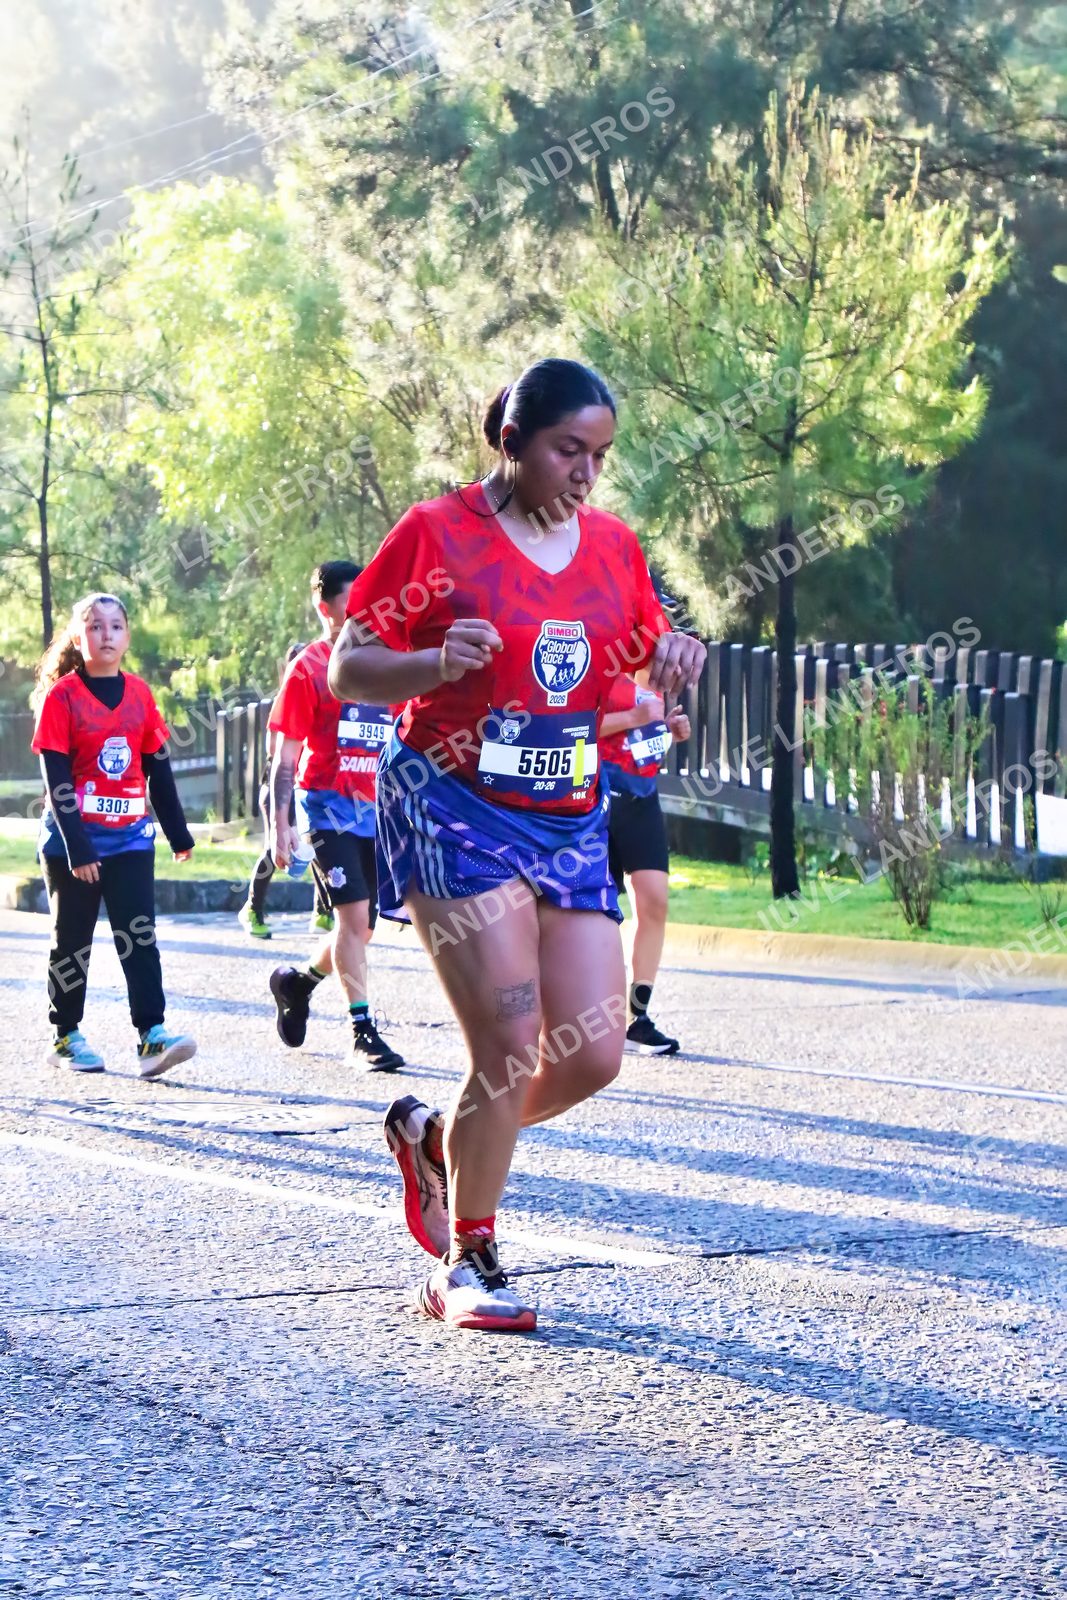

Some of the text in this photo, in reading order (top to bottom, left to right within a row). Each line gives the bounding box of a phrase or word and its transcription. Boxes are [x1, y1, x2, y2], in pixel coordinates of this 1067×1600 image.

[547, 627, 579, 637] BIMBO
[547, 640, 578, 654] Global
[541, 651, 564, 664] Race
[549, 695, 566, 704] 2026
[359, 724, 385, 740] 3949
[518, 749, 572, 776] 5505
[572, 790, 587, 800] 10K
[97, 798, 130, 814] 3303
